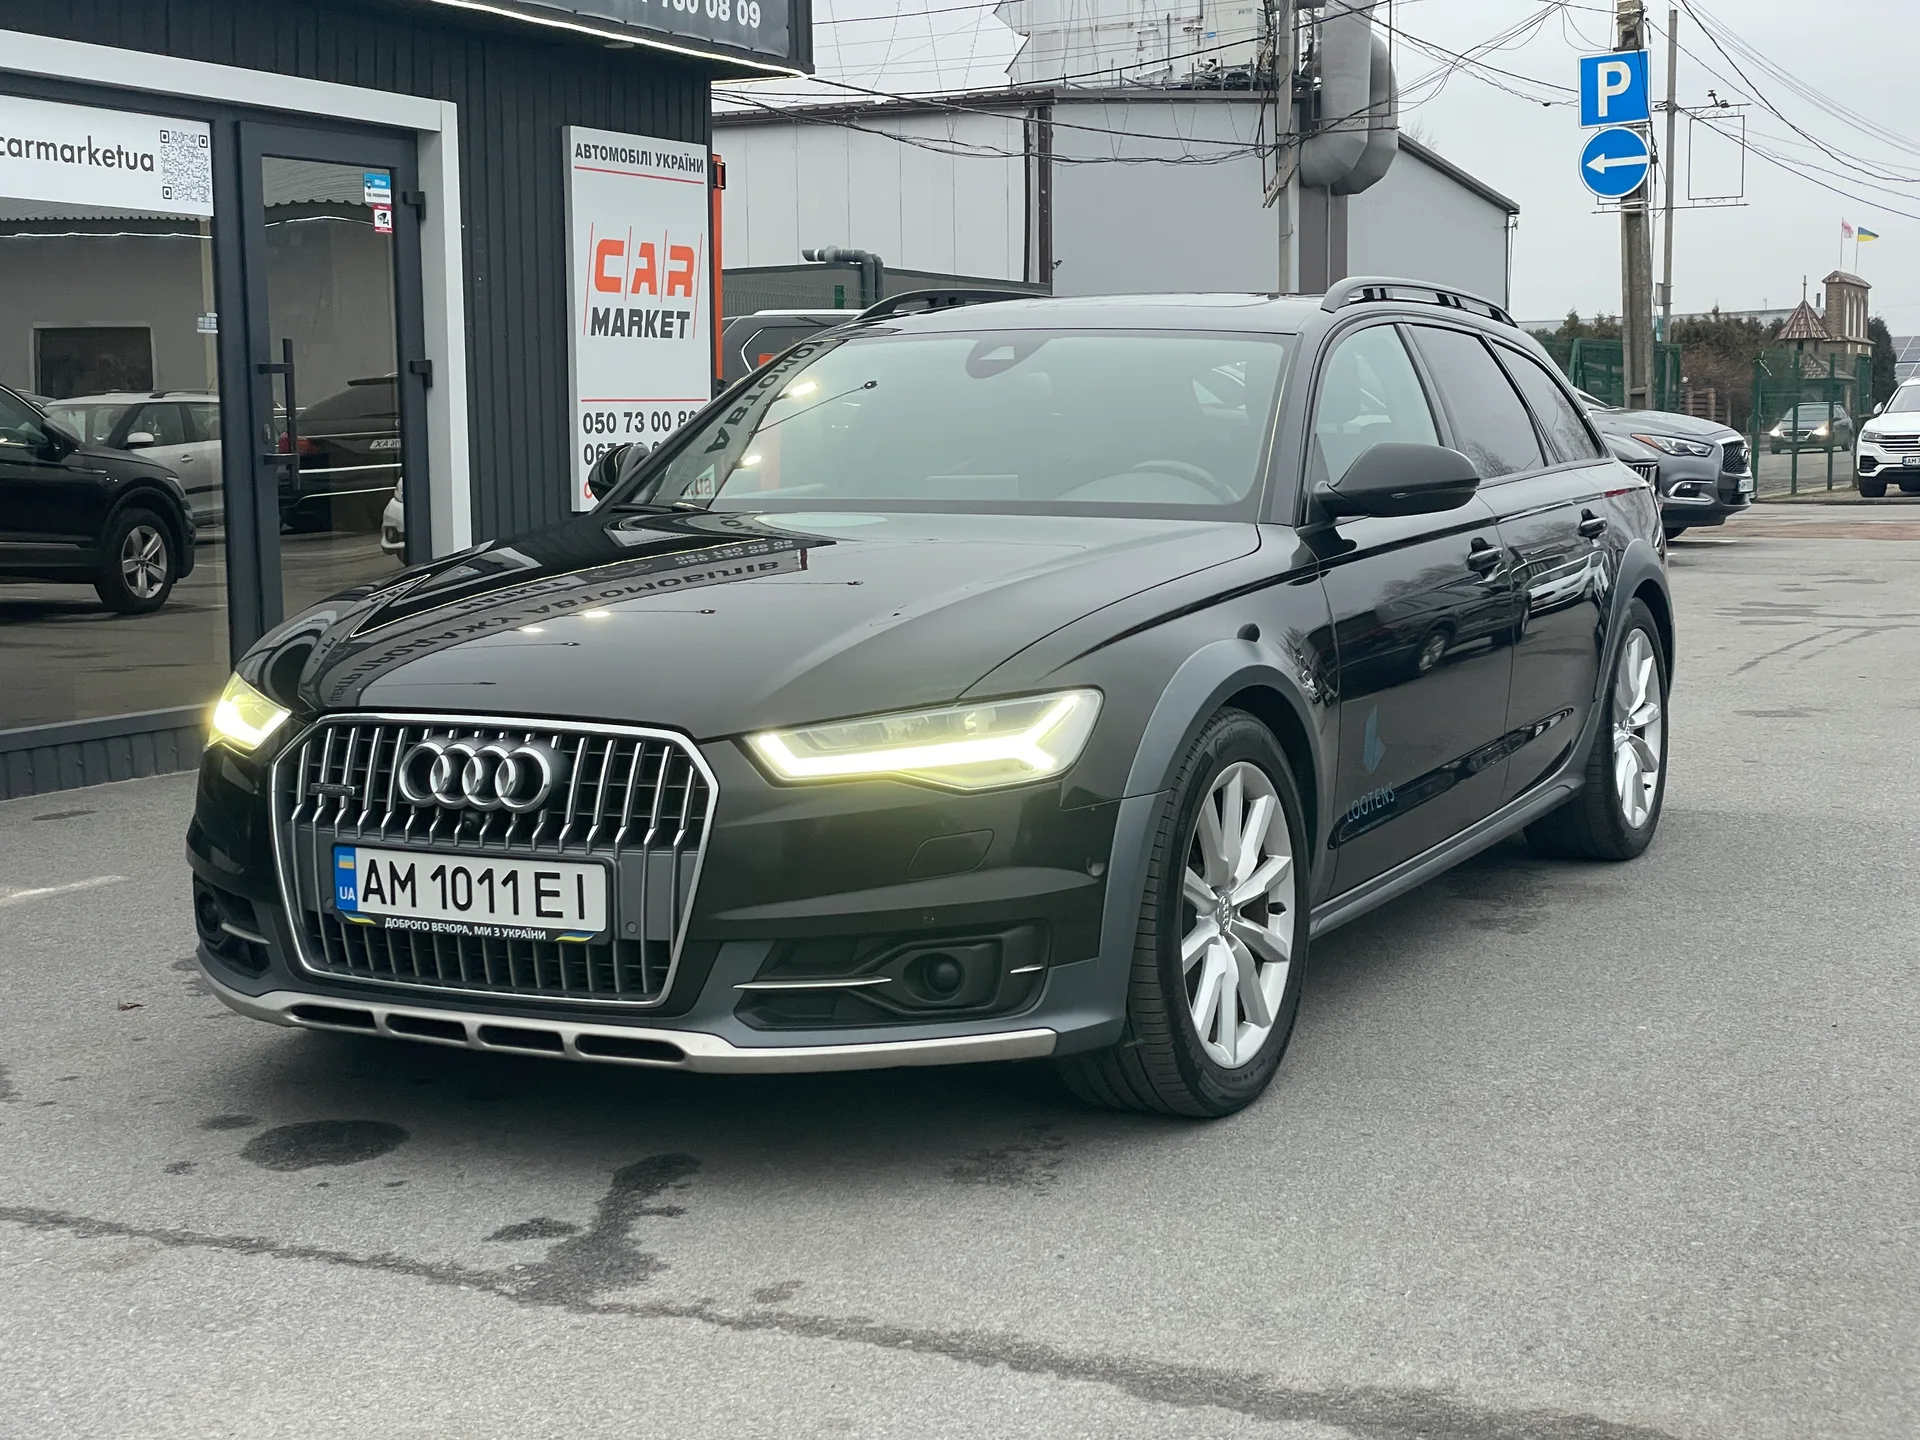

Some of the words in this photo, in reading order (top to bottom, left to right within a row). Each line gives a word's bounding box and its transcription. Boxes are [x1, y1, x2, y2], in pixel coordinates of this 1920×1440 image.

[737, 0, 761, 28] 09
[1597, 61, 1632, 118] P
[575, 142, 652, 167] АВТОМОБІЛІ
[655, 152, 704, 174] УКРАЇНИ
[594, 238, 695, 298] CAR
[590, 306, 691, 339] MARKET
[582, 411, 617, 435] 050
[623, 411, 645, 433] 73
[651, 410, 672, 432] 00
[583, 441, 617, 466] 06
[1345, 781, 1395, 823] LOOTENS
[339, 886, 356, 901] UA
[362, 858, 417, 908] AM
[430, 864, 520, 916] 1011
[534, 871, 586, 920] EI
[384, 917, 430, 932] ДОБРОГО
[431, 922, 473, 936] ВЕЧОРА,
[474, 925, 492, 937] МИ
[501, 927, 547, 941] УКРАЇНИ
